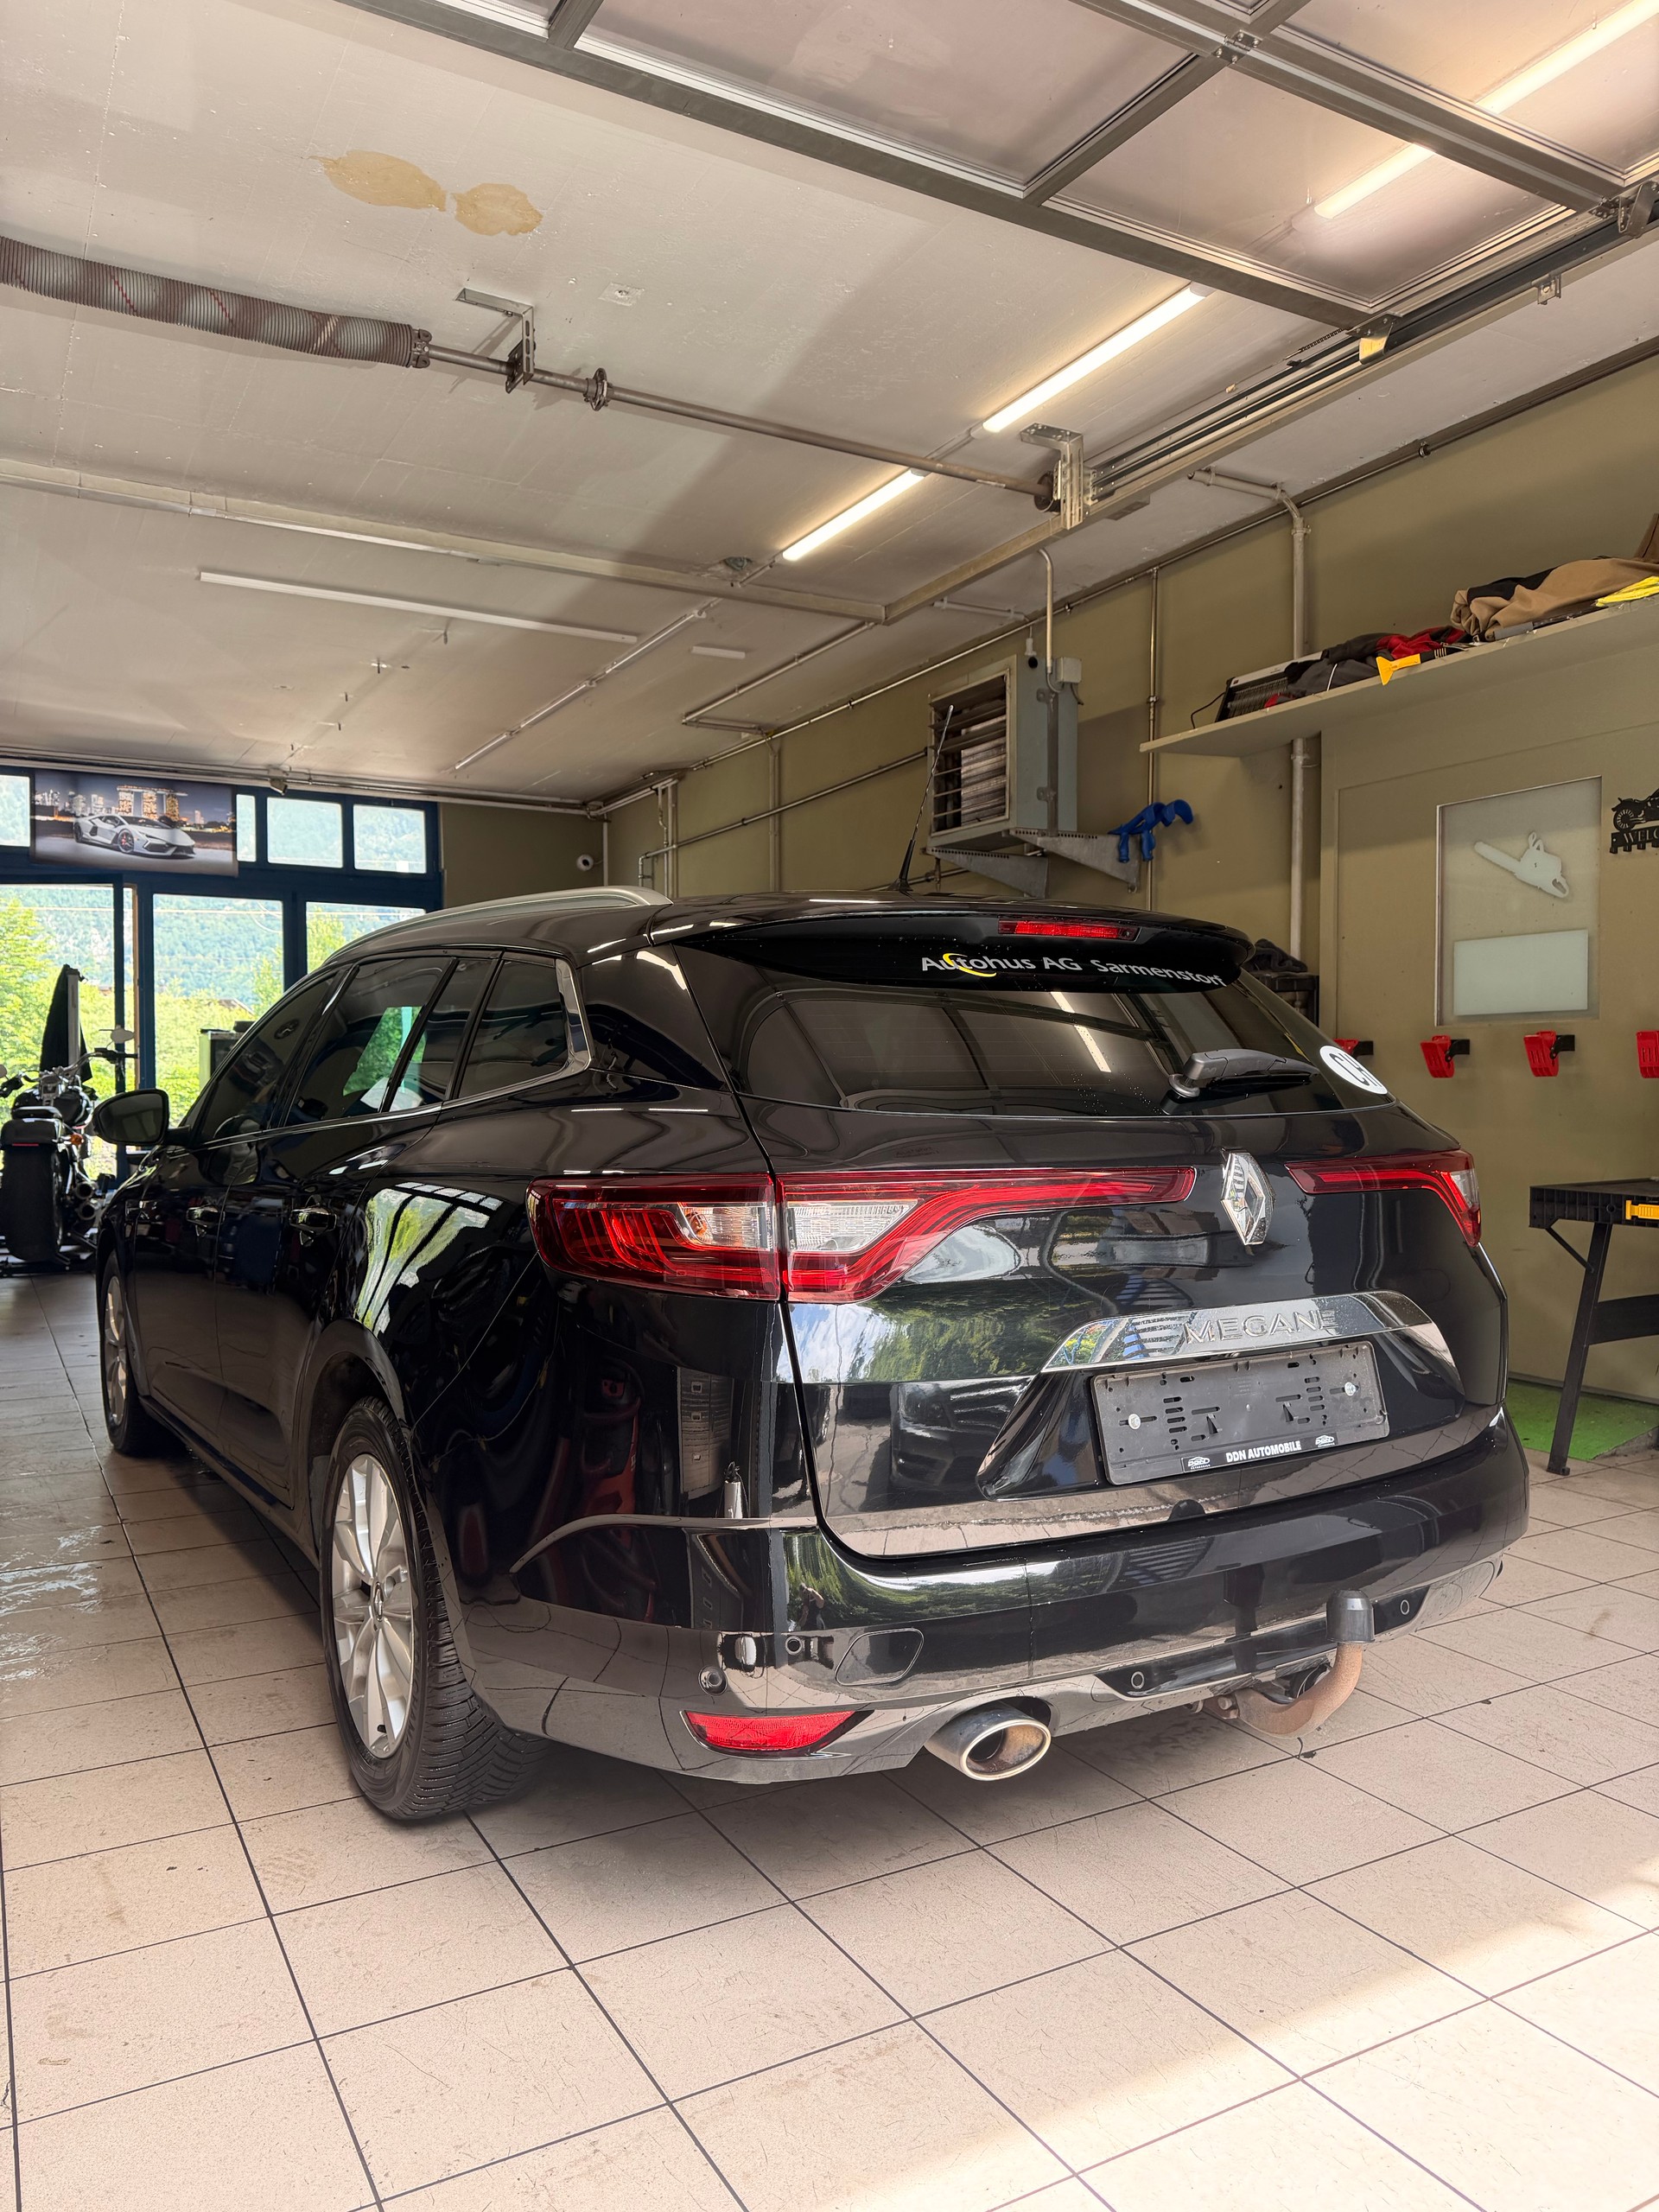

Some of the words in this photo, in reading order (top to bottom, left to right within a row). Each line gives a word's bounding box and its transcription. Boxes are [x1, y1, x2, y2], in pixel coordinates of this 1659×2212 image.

[921, 954, 1037, 974] Autohus
[1043, 957, 1082, 971] AG
[1091, 959, 1228, 988] Sarmenstorf
[1183, 1308, 1340, 1344] MEGANE
[1225, 1449, 1247, 1463] DDN
[1248, 1440, 1302, 1460] AUTOMOBILE
